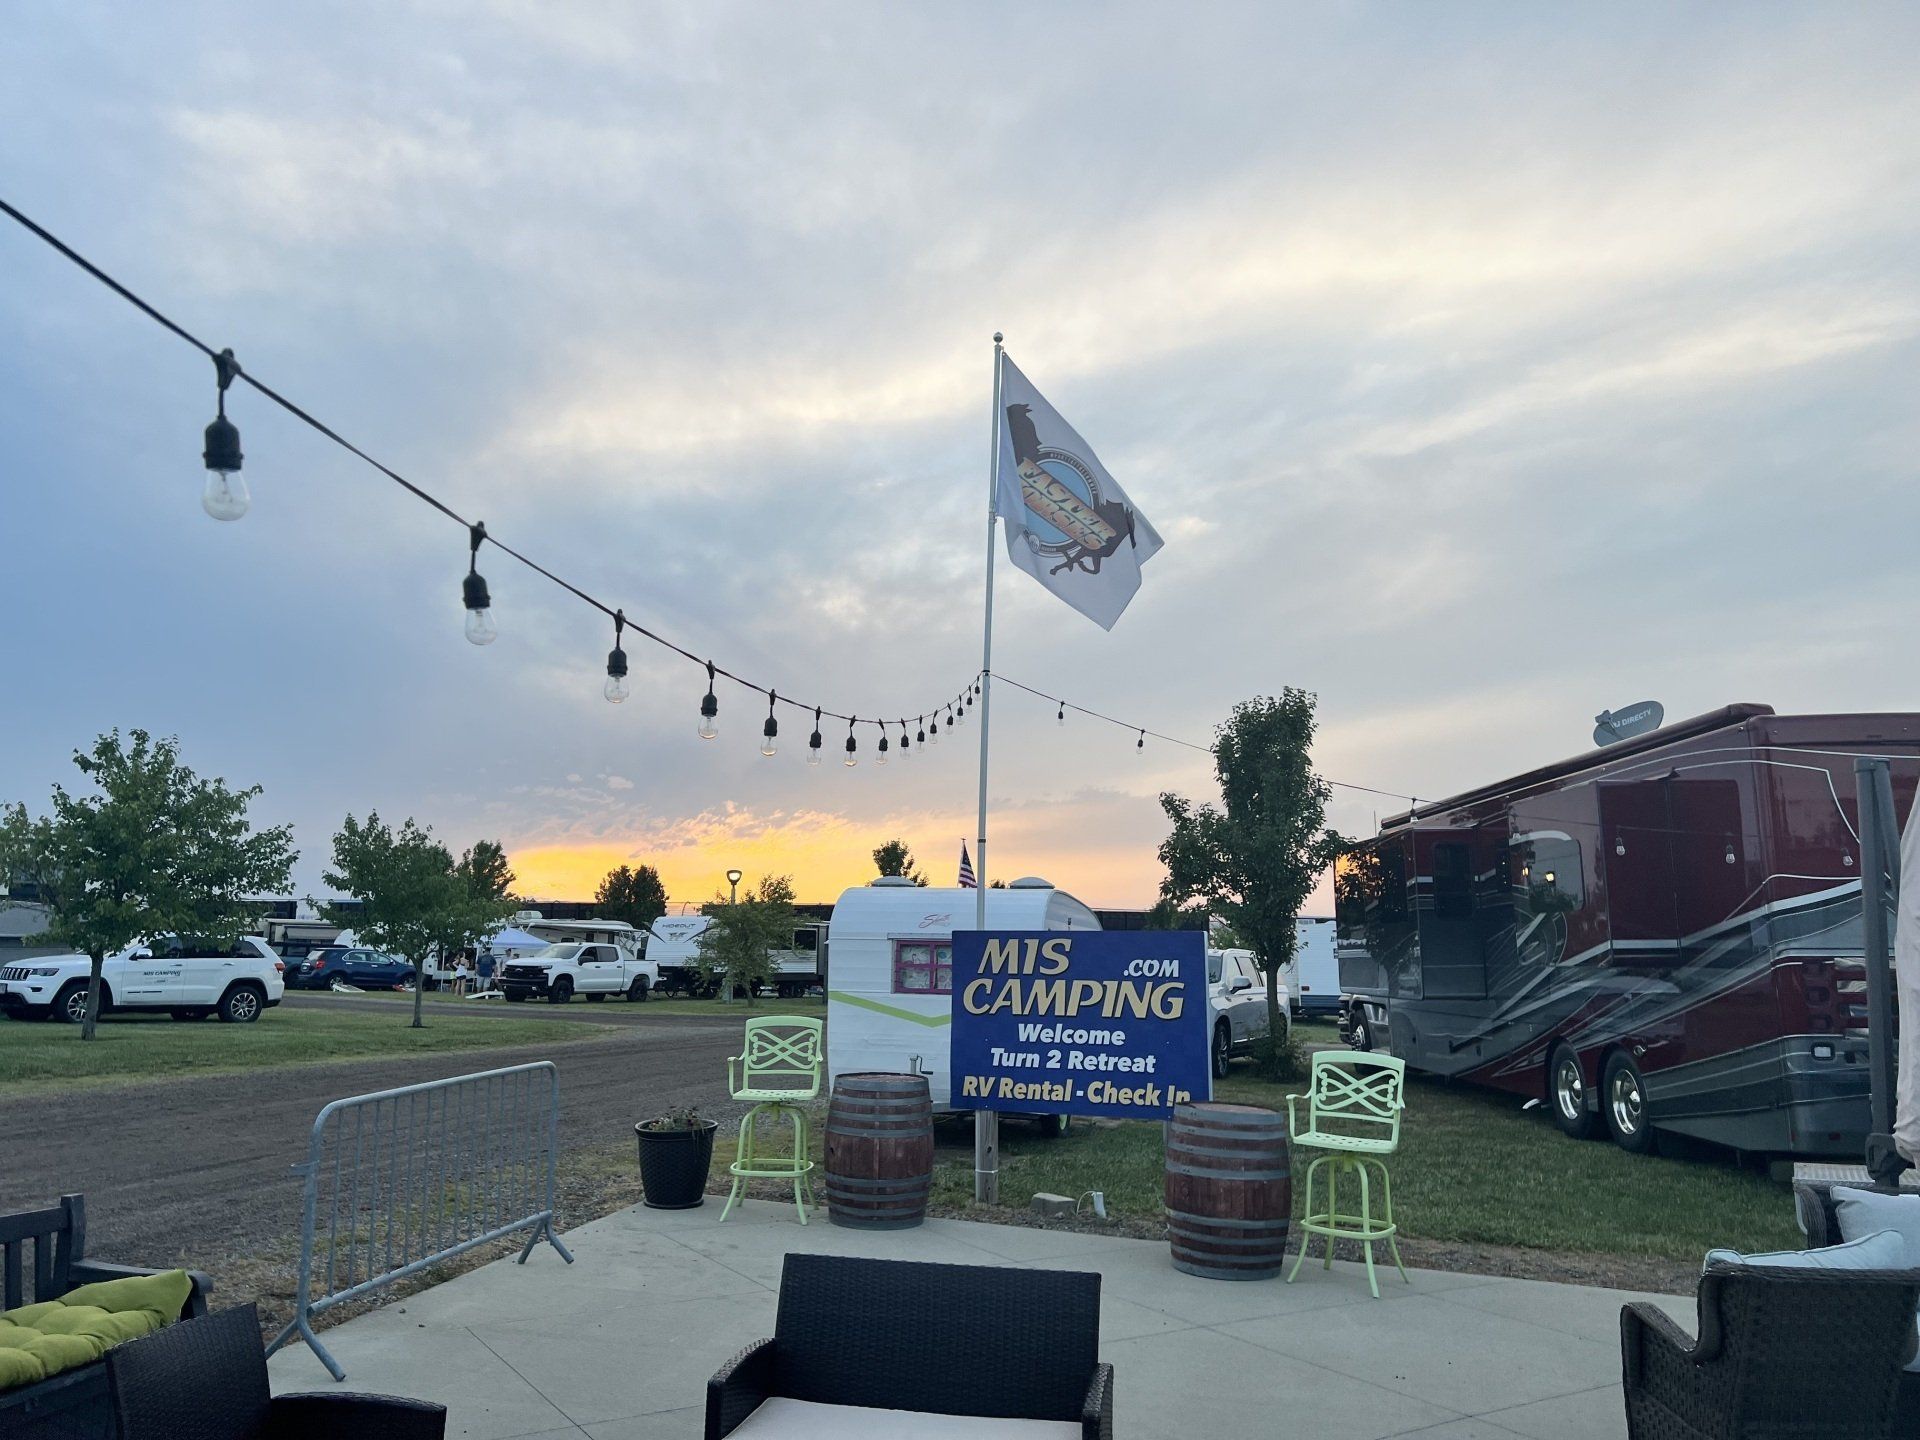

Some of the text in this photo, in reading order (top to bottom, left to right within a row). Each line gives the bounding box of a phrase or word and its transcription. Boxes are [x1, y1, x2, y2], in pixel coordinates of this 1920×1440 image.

[1622, 708, 1651, 726] DIRECTV
[977, 938, 1072, 975] MIS
[1123, 959, 1179, 978] .COM
[963, 978, 1185, 1020] CAMPING
[1018, 1023, 1126, 1046] Welcome
[991, 1047, 1156, 1074] Turn 2 Retreat
[962, 1076, 996, 1098] RV
[998, 1077, 1073, 1102] Rental
[1087, 1080, 1161, 1107] Check
